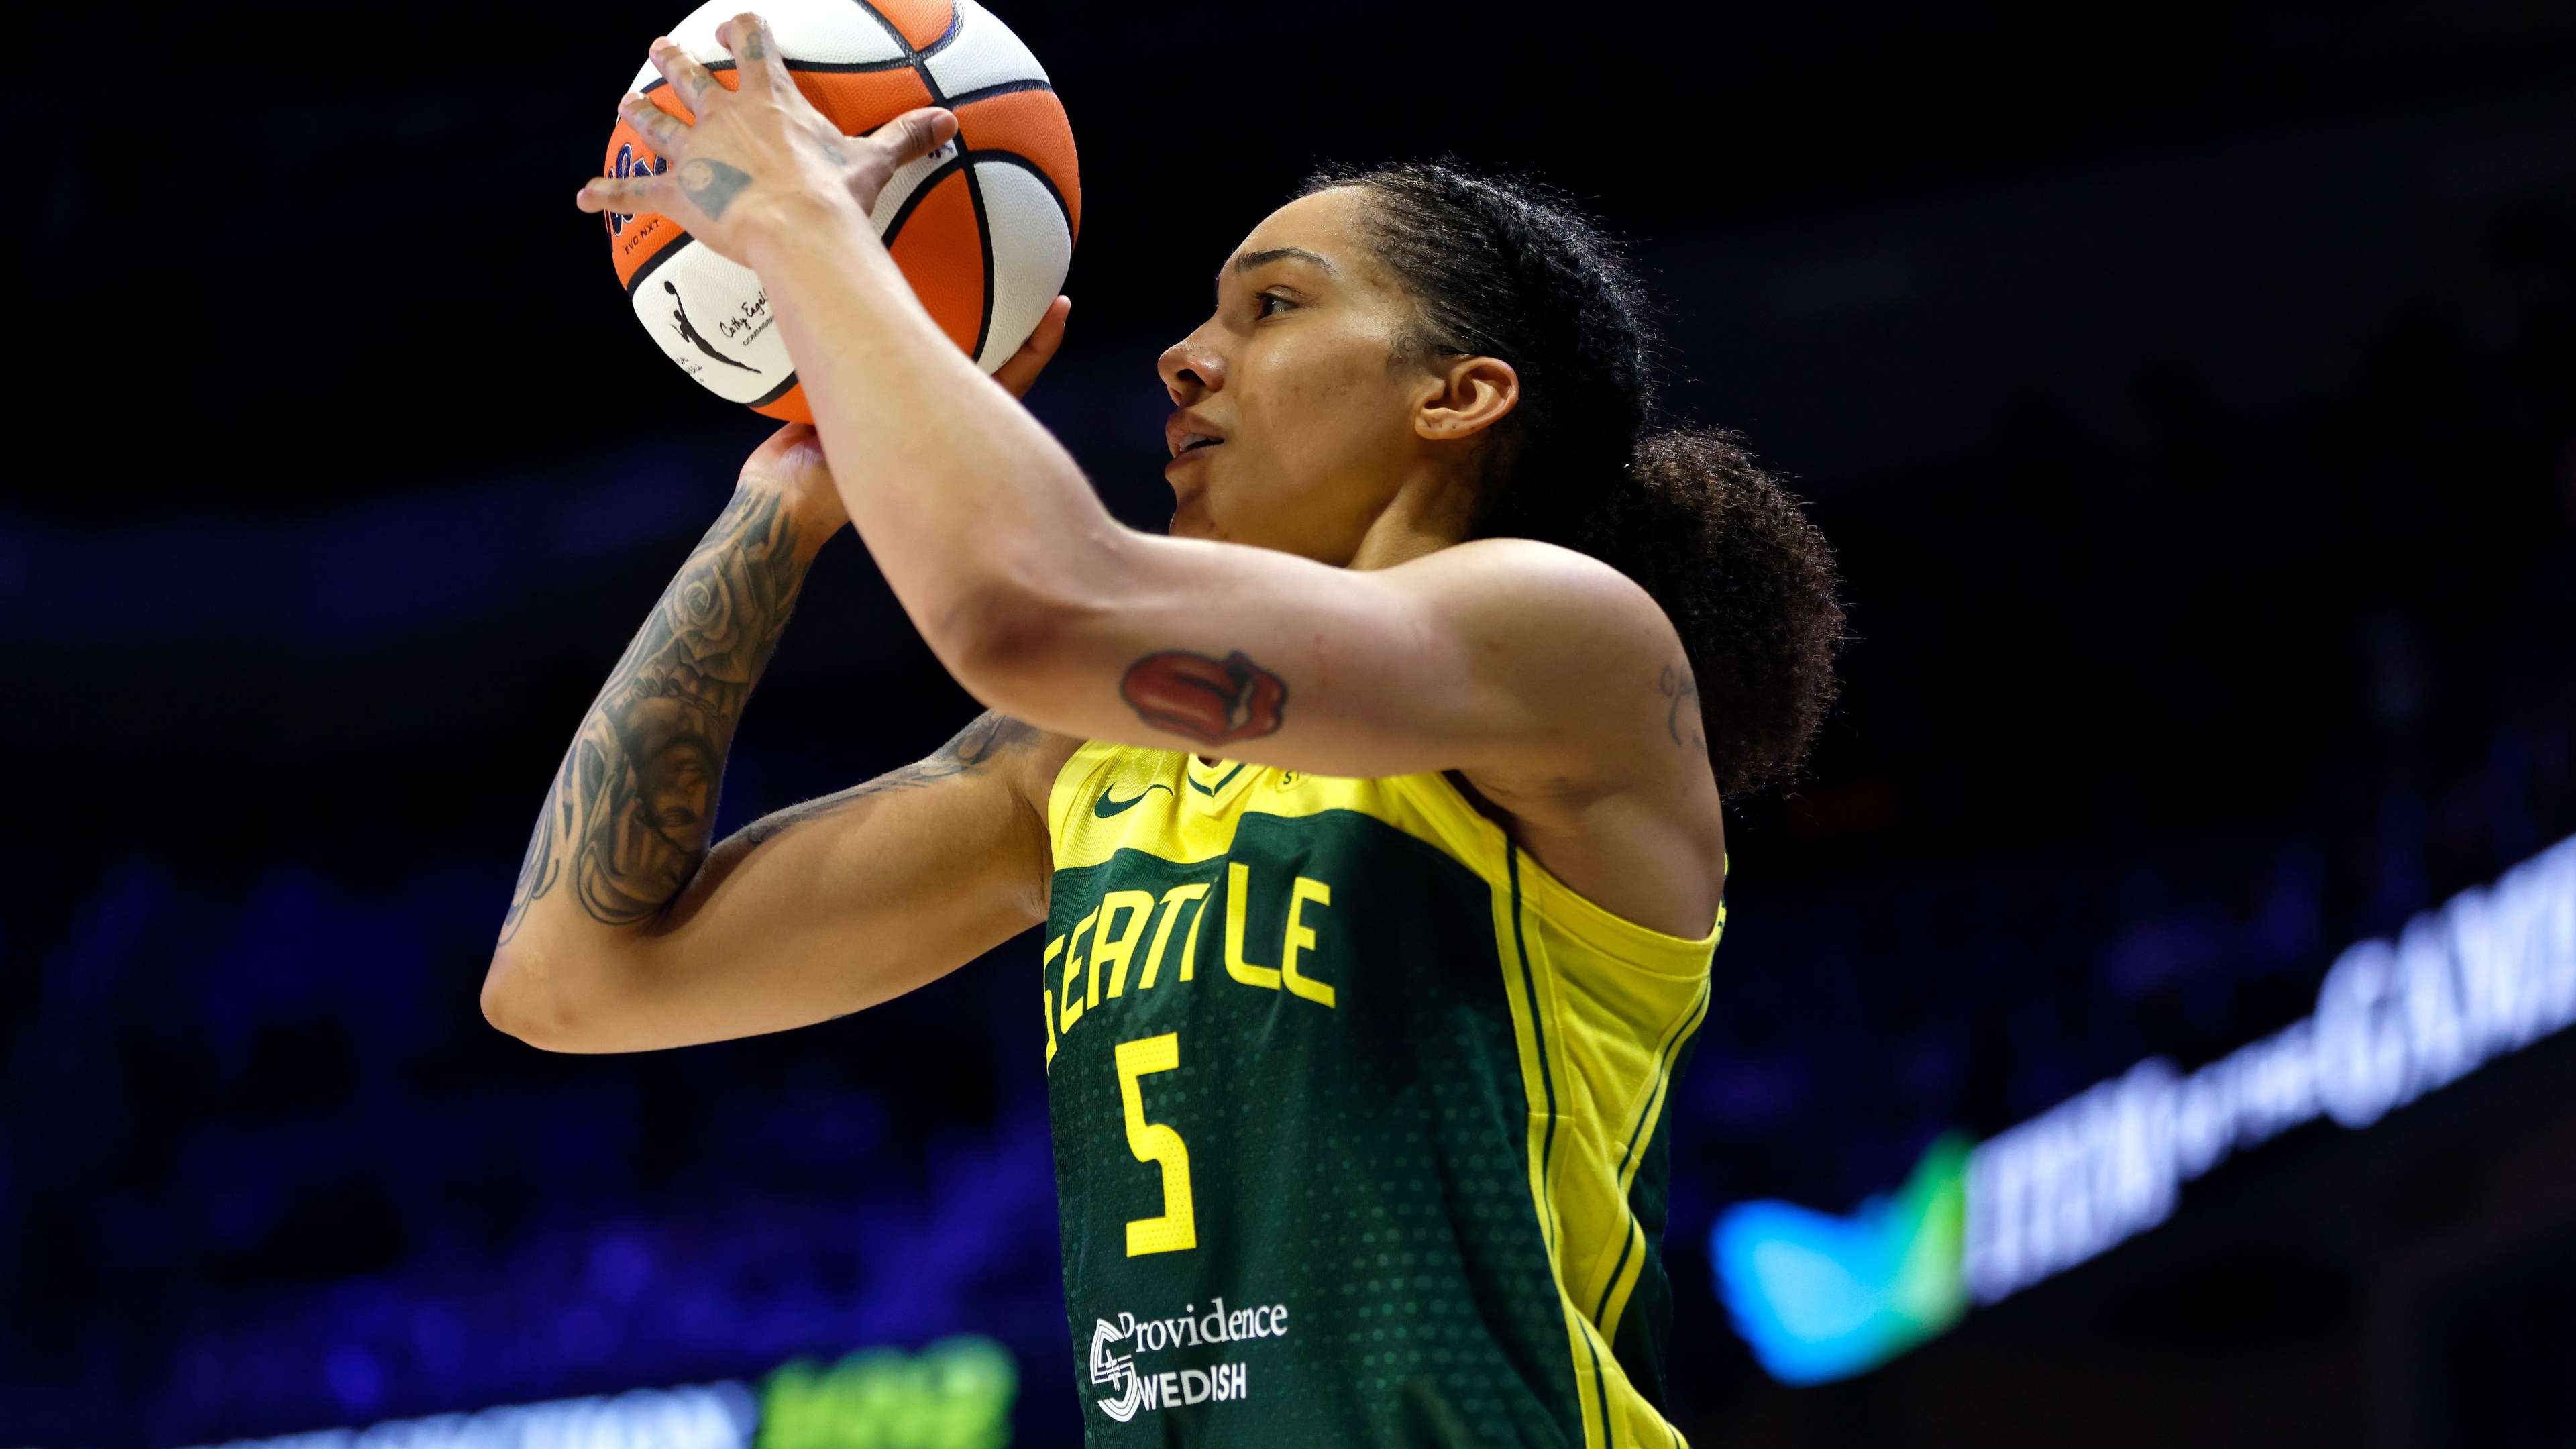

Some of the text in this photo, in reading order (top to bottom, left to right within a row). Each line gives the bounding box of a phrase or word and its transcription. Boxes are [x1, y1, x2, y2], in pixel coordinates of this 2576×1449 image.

[640, 219, 659, 239] NXT
[720, 316, 751, 339] Cathy
[1115, 1032, 1197, 1258] 5
[1118, 1297, 1288, 1352] Providence
